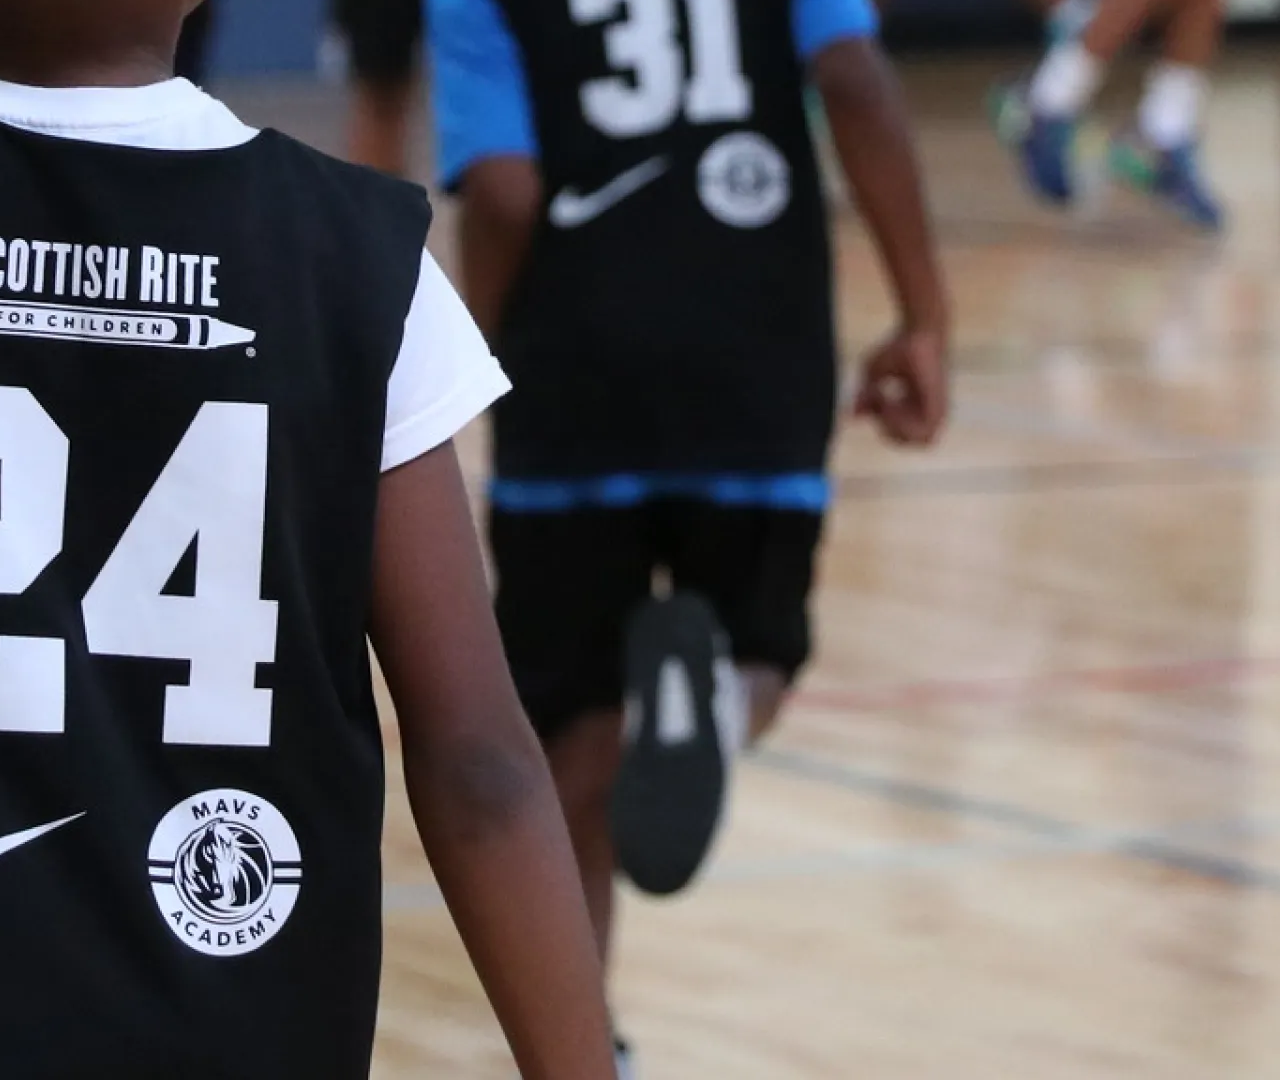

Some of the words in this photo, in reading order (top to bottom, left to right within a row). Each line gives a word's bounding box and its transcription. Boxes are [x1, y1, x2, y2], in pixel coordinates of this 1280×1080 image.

[47, 314, 164, 336] CHILDREN
[191, 798, 261, 821] MAVS
[170, 907, 276, 947] ACADEMY
